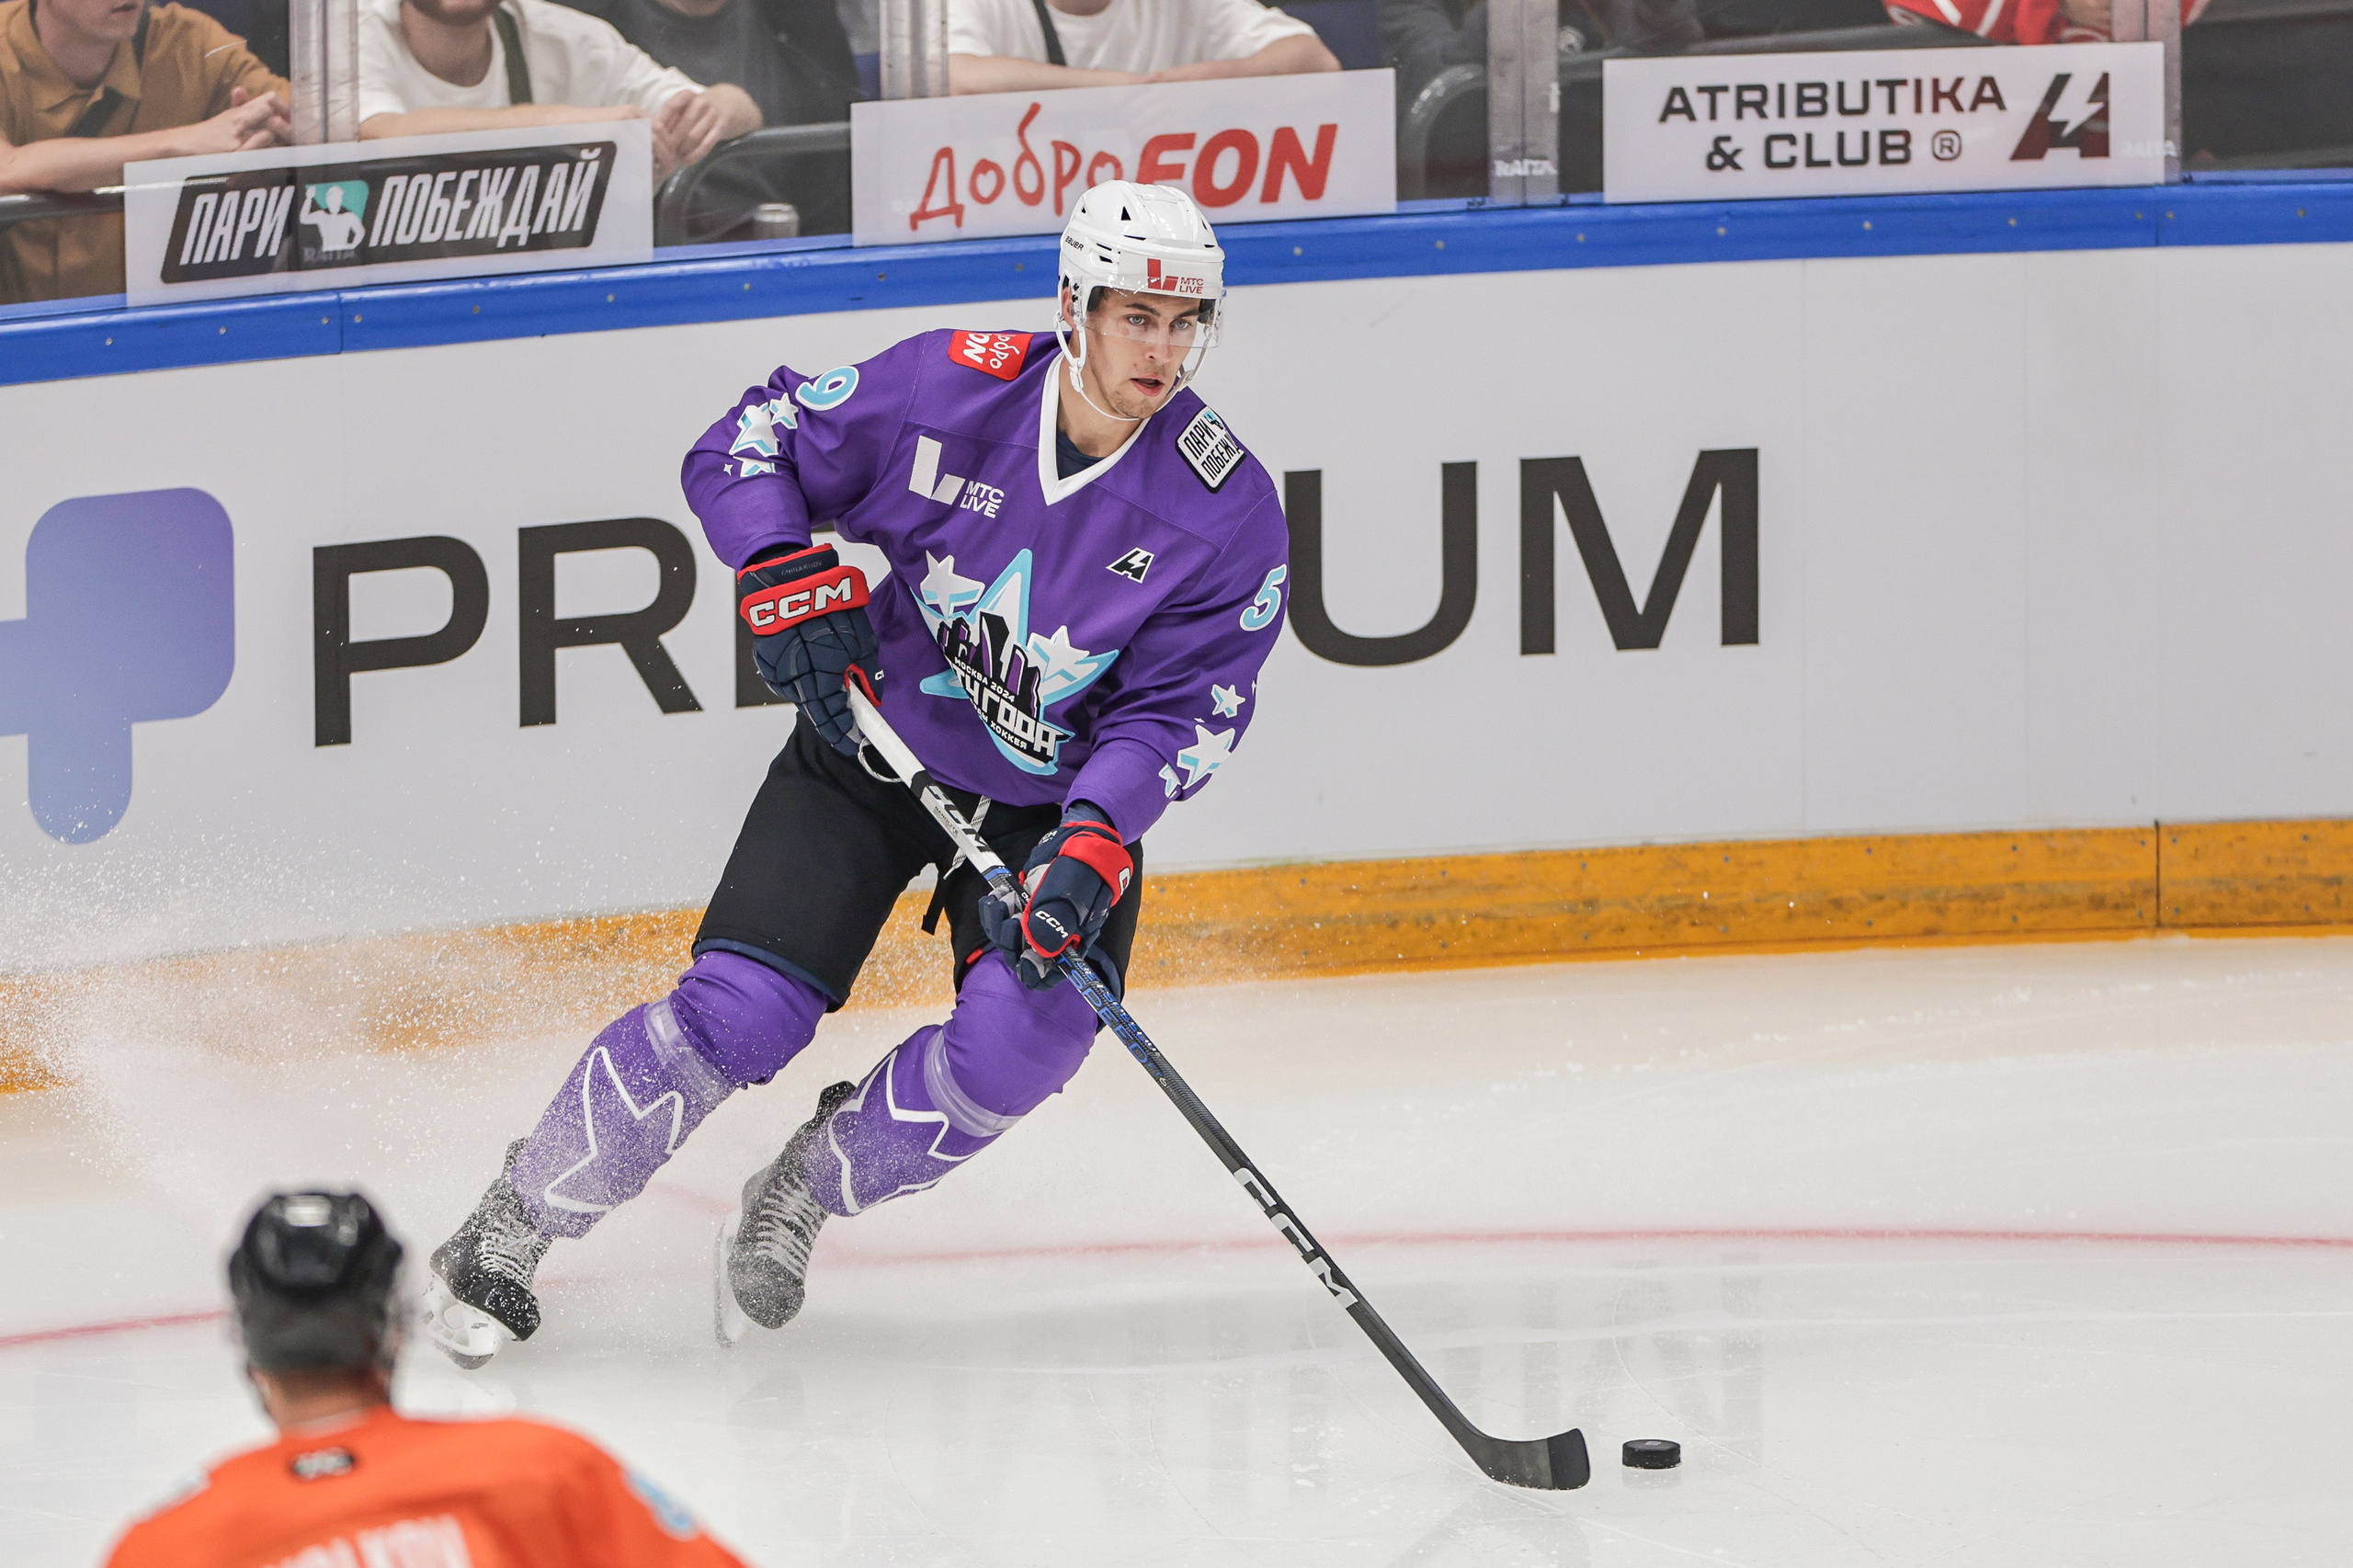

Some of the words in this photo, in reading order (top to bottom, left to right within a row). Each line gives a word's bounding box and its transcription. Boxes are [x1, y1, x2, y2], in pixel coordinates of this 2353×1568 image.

[1658, 74, 2008, 124] ATRIBUTIKA
[1705, 136, 1745, 172] &
[1764, 131, 1913, 168] CLUB
[179, 185, 296, 267] ПАРИ
[369, 149, 602, 250] ПОБЕЖДАЙ
[1064, 235, 1085, 251] BAUER
[1179, 285, 1204, 294] LIVE
[962, 332, 993, 364] ON
[1183, 418, 1218, 460] ПАРИ
[960, 494, 1000, 519] LIVE
[313, 447, 1759, 747] PRUM
[748, 575, 853, 628] CCM
[1238, 562, 1288, 632] 5
[954, 656, 989, 686] МОСКВА
[990, 680, 1016, 703] 2024
[990, 720, 1028, 750] ХОККЕЯ
[1034, 910, 1069, 939] CCM
[1057, 953, 1148, 1063] TSPEED
[1233, 1166, 1359, 1310] CCM
